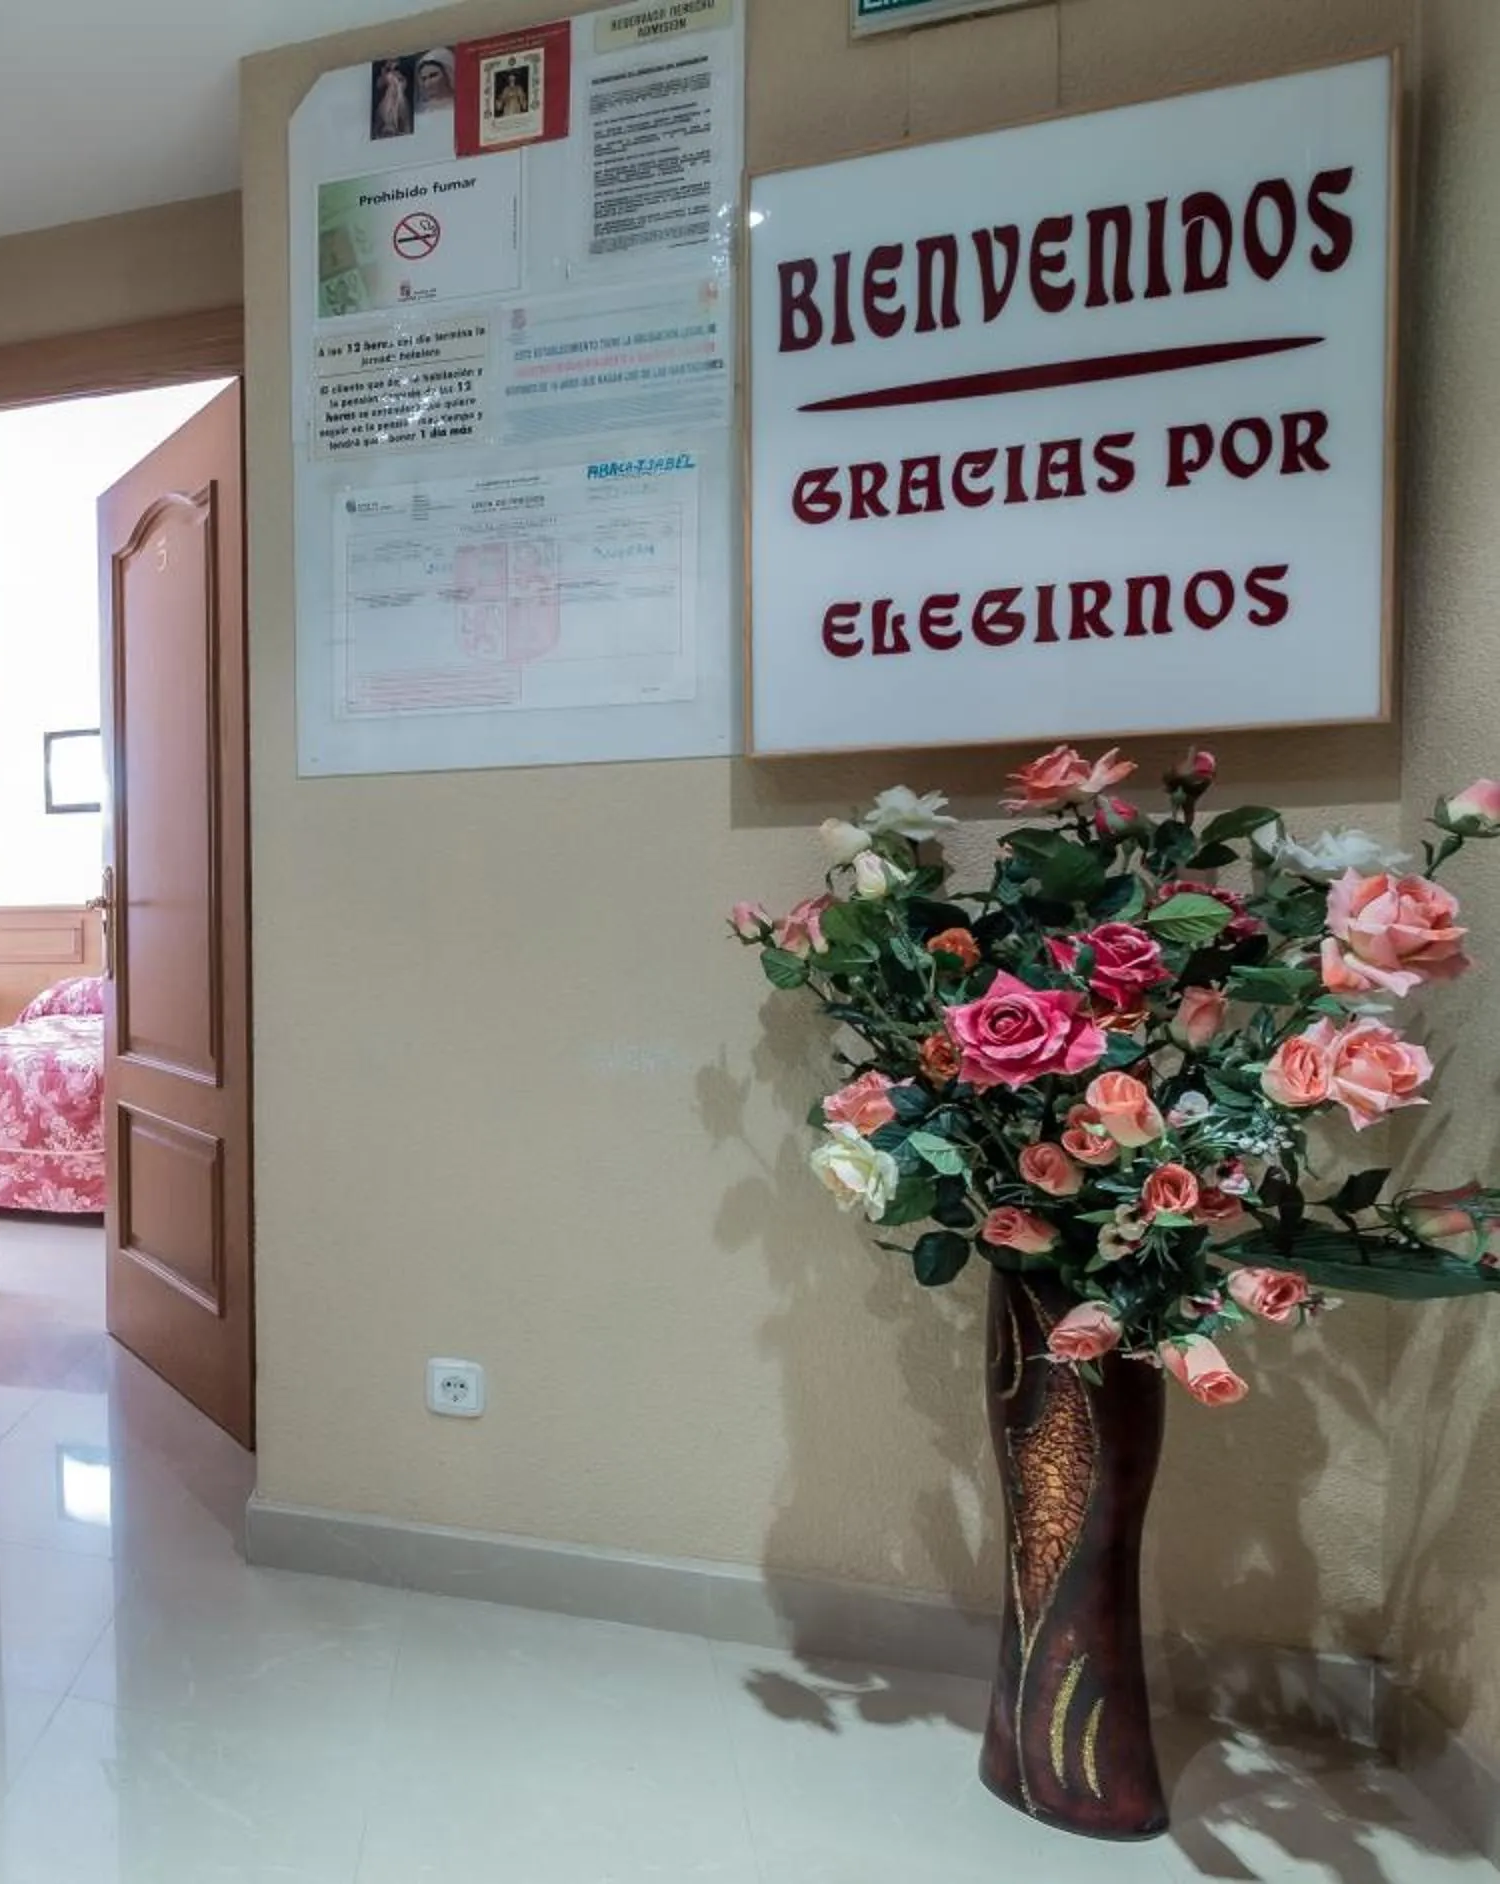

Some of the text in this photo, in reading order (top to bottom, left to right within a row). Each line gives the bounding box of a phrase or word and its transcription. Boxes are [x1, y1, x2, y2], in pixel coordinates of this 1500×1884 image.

[359, 177, 477, 206] Prohibido fumar
[777, 165, 1355, 354] BIENVENIDOS
[347, 341, 361, 353] 12
[458, 380, 471, 392] 12
[792, 409, 1332, 525] GRACIAS POR
[821, 562, 1290, 659] ELEGIRNOS
